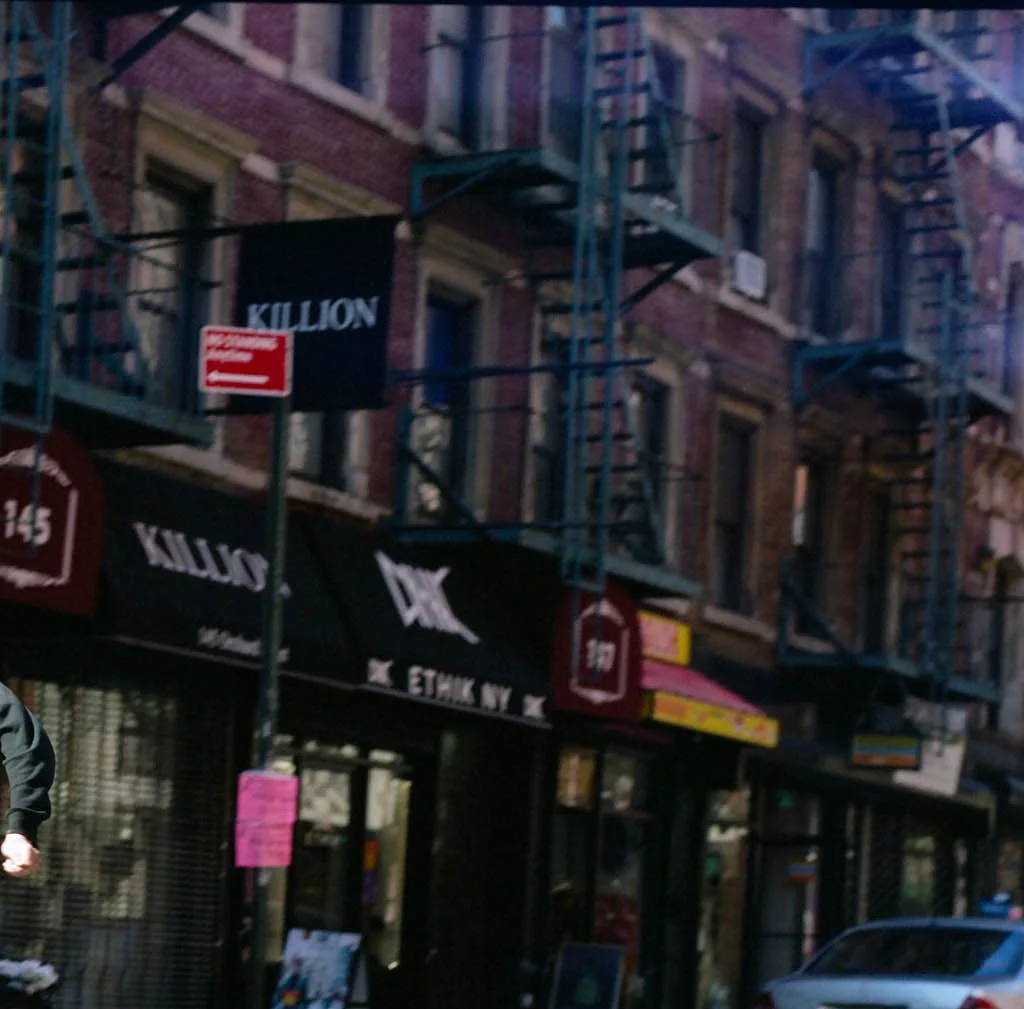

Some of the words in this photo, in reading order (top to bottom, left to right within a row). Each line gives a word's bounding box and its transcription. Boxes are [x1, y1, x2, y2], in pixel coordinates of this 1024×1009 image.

[246, 296, 379, 331] KILLION
[3, 500, 52, 545] 145
[132, 521, 292, 598] KILLIO
[407, 665, 476, 705] ETHIK
[479, 682, 512, 712] NY
